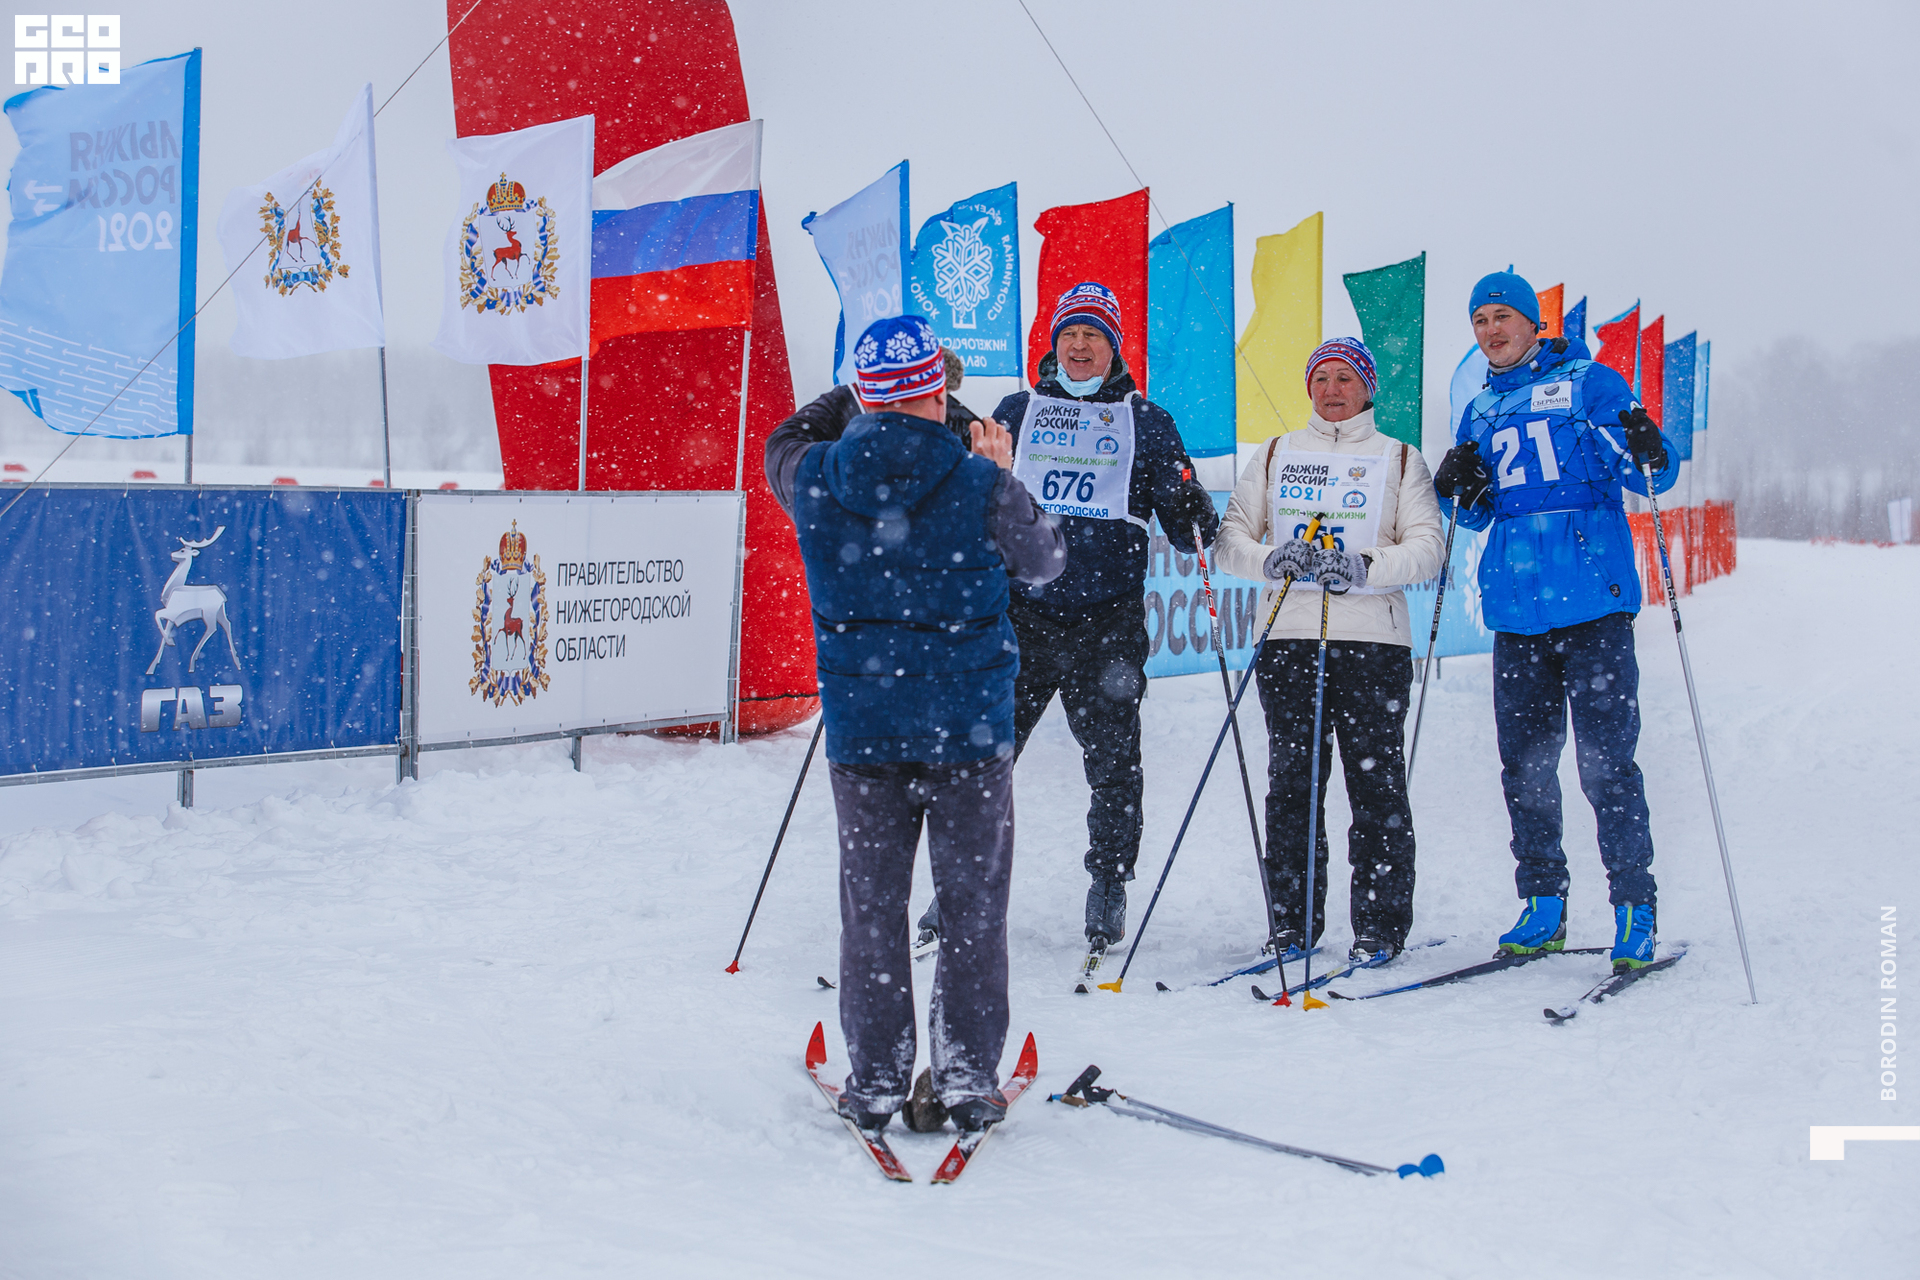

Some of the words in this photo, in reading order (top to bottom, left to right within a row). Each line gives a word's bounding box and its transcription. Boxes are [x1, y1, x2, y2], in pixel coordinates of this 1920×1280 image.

[1532, 396, 1570, 408] СБЕРБАНК
[1033, 417, 1079, 431] РОССИИ
[1030, 430, 1076, 447] 2021
[1028, 453, 1052, 463] СПОРТ
[1057, 455, 1089, 466] НОРМА
[1089, 457, 1119, 467] ЖИЗНИ
[1491, 419, 1561, 490] 21
[1281, 463, 1329, 476] ЛЫЖНЯ
[1042, 469, 1096, 503] 676
[1280, 473, 1328, 487] РОССИИ
[1279, 485, 1322, 502] 2021
[1278, 507, 1301, 517] СПОРТ
[1336, 511, 1367, 520] ЖИЗНИ
[557, 559, 684, 587] ПРАВИТЕЛЬСТВО
[556, 589, 691, 625] НИЖЕГОРОДСКОЙ
[1145, 587, 1257, 658] ОССИИ
[555, 634, 626, 662] ОБЛАСТИ
[140, 684, 244, 733] ГАЗ
